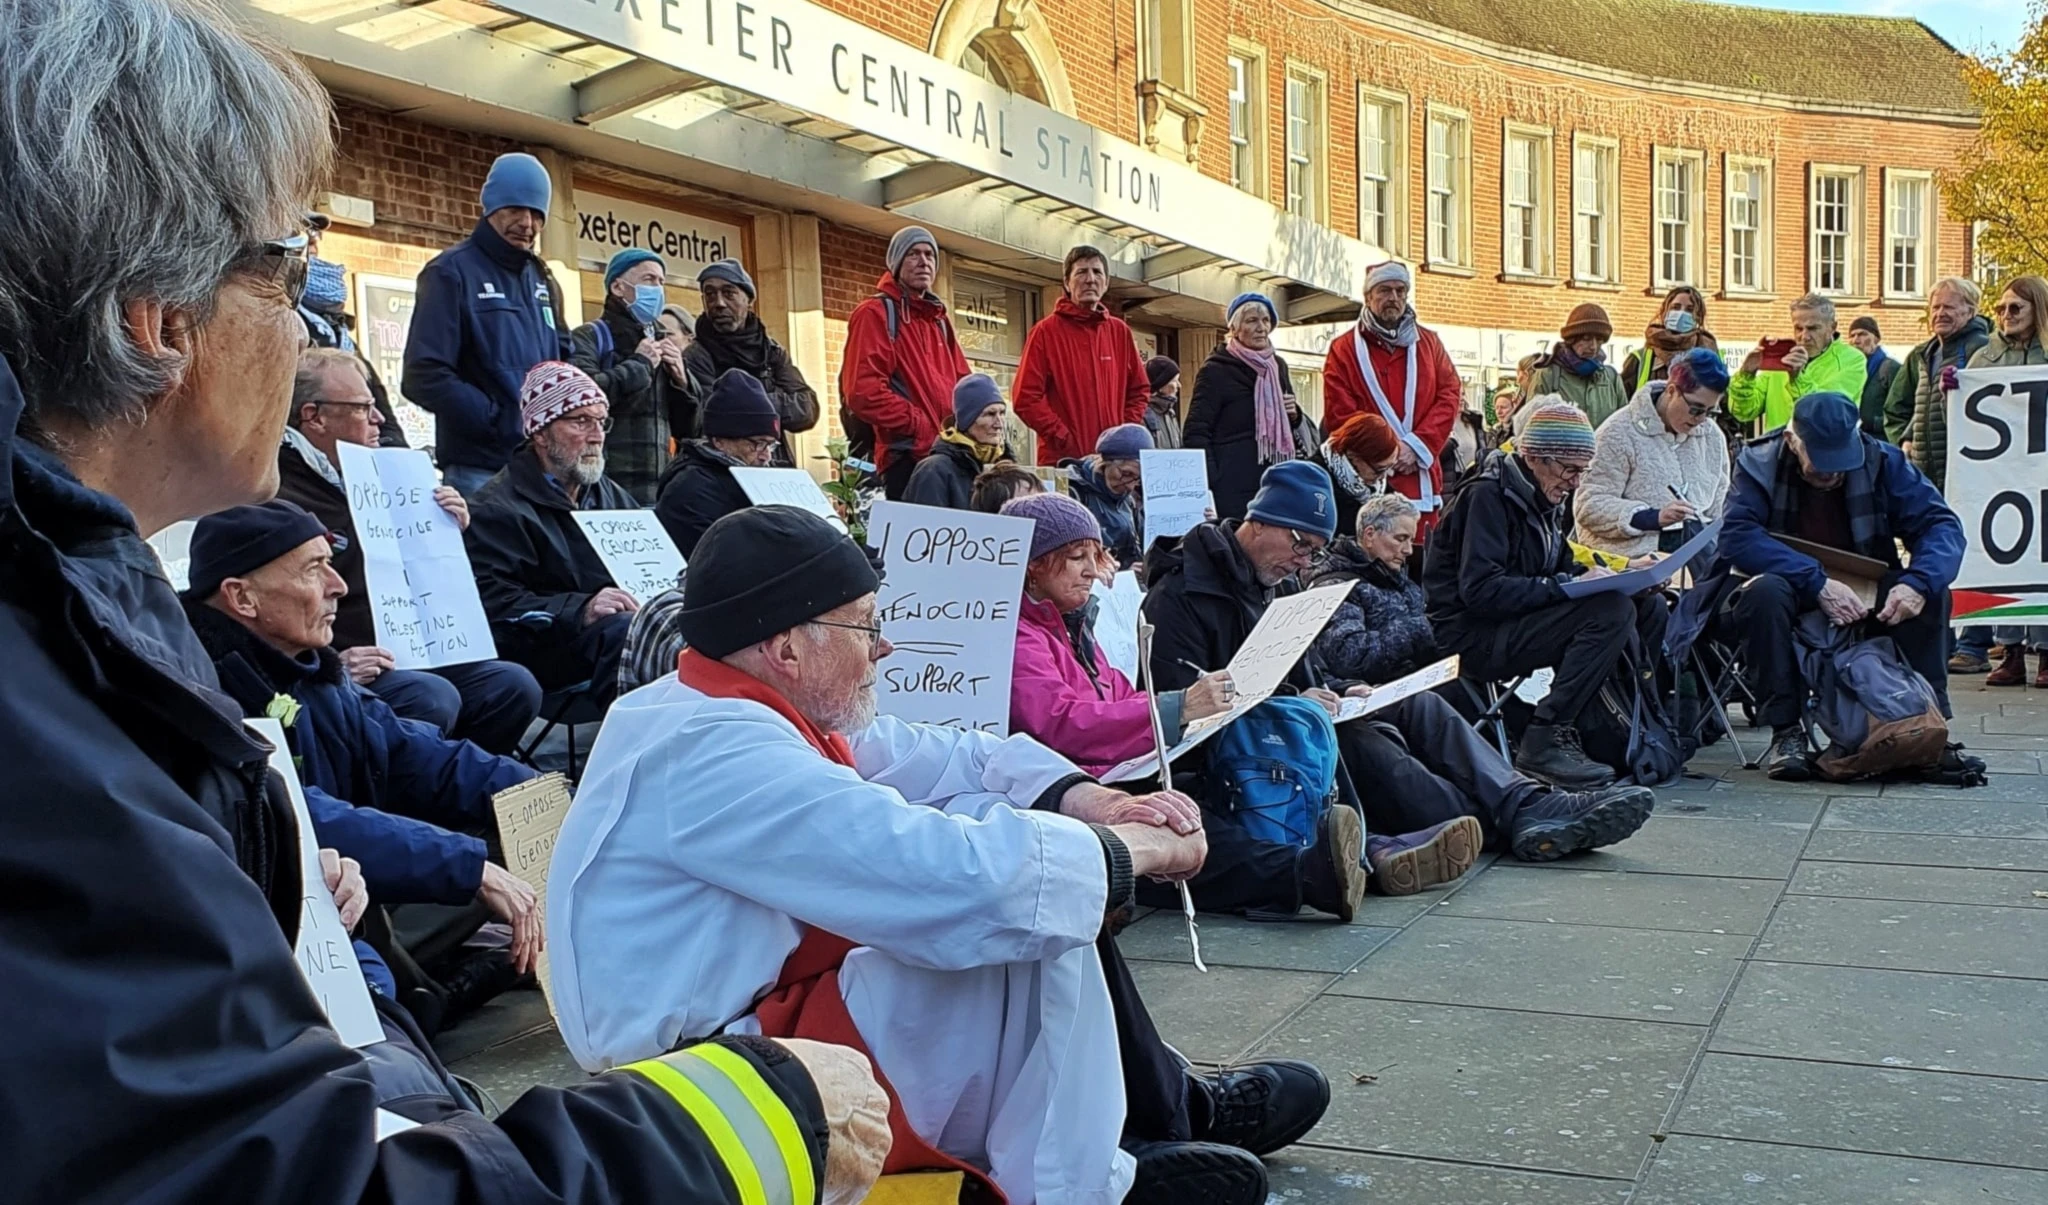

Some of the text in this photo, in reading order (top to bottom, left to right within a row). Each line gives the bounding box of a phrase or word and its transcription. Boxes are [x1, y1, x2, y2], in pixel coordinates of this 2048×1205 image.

[831, 43, 1013, 158] CENTRAL
[1037, 127, 1161, 213] STATION
[648, 220, 727, 263] Central
[353, 483, 422, 511] OPPOSE
[586, 521, 599, 534] I
[880, 522, 1020, 565] I OPPOSE
[1981, 489, 2048, 565] O
[381, 592, 432, 608] SUPPORT
[383, 613, 455, 638] PALESTINE
[410, 633, 468, 658] ACTION
[885, 663, 991, 696] SUPPORT
[508, 792, 555, 835] I OPPOSE
